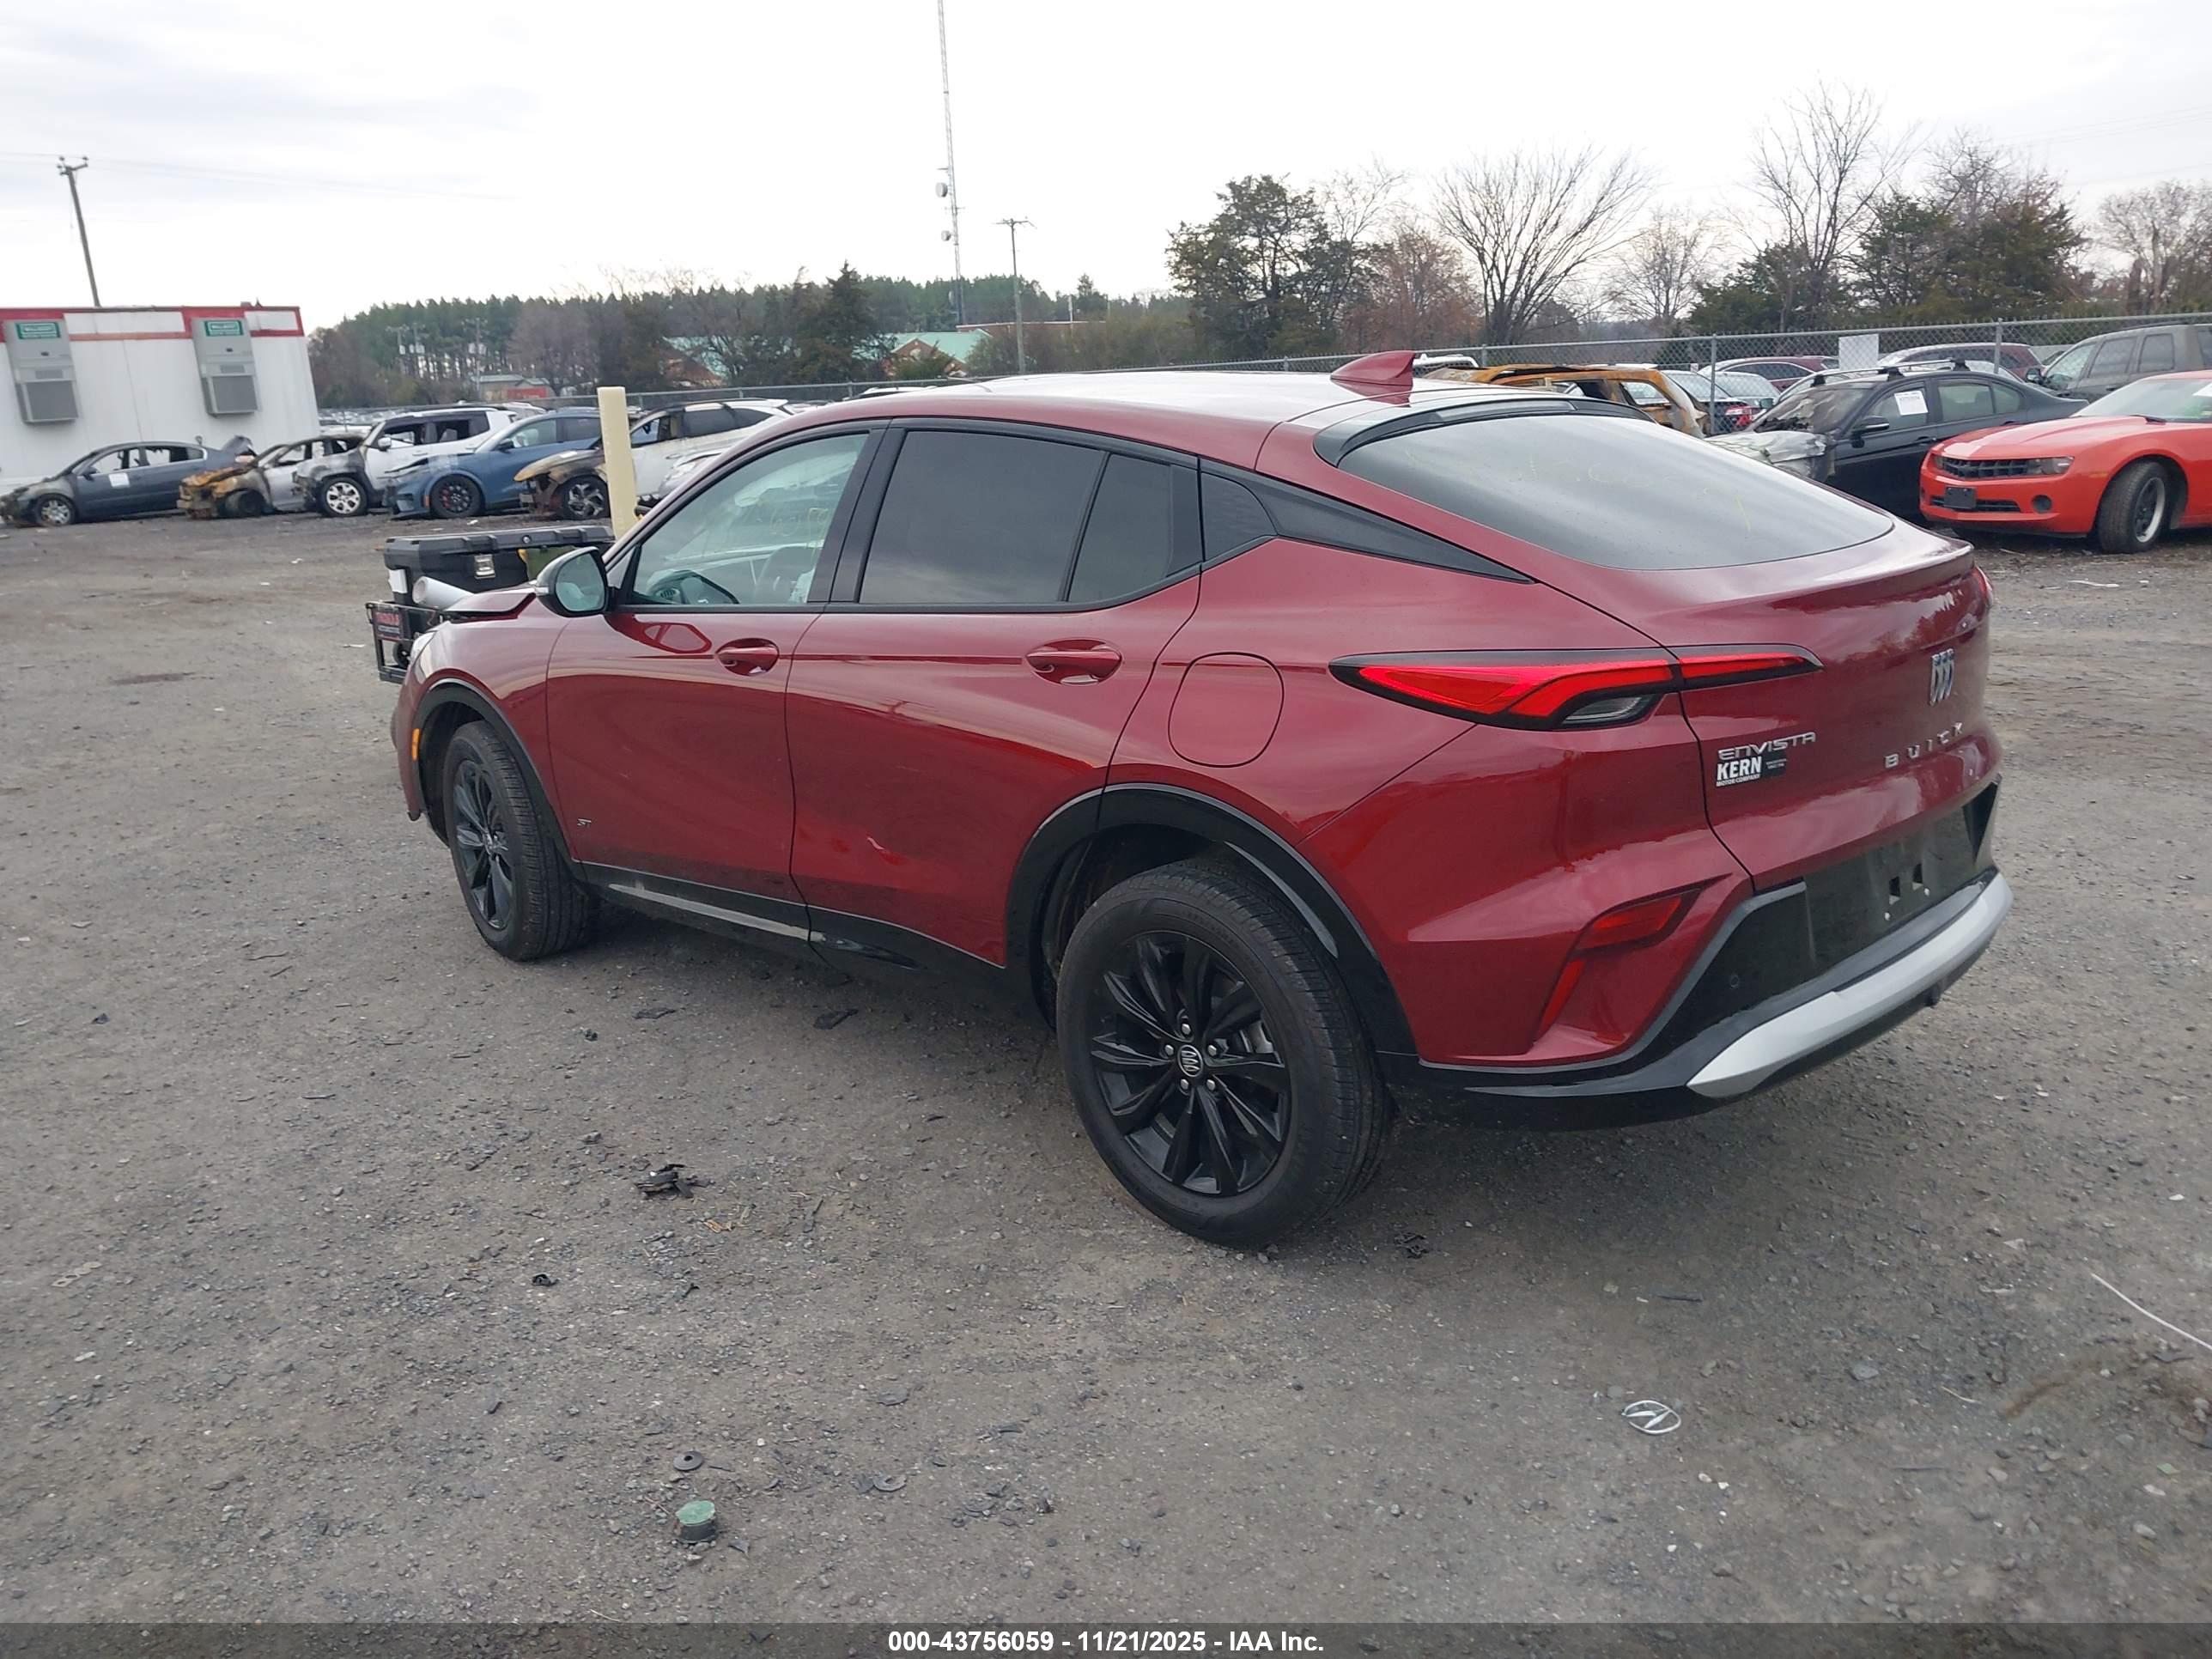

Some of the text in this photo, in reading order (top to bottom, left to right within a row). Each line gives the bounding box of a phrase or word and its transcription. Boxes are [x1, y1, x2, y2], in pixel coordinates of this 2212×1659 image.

[1717, 732, 1816, 761] ENVISTA
[1884, 721, 1963, 769] BUICK
[1717, 756, 1762, 781] KERN
